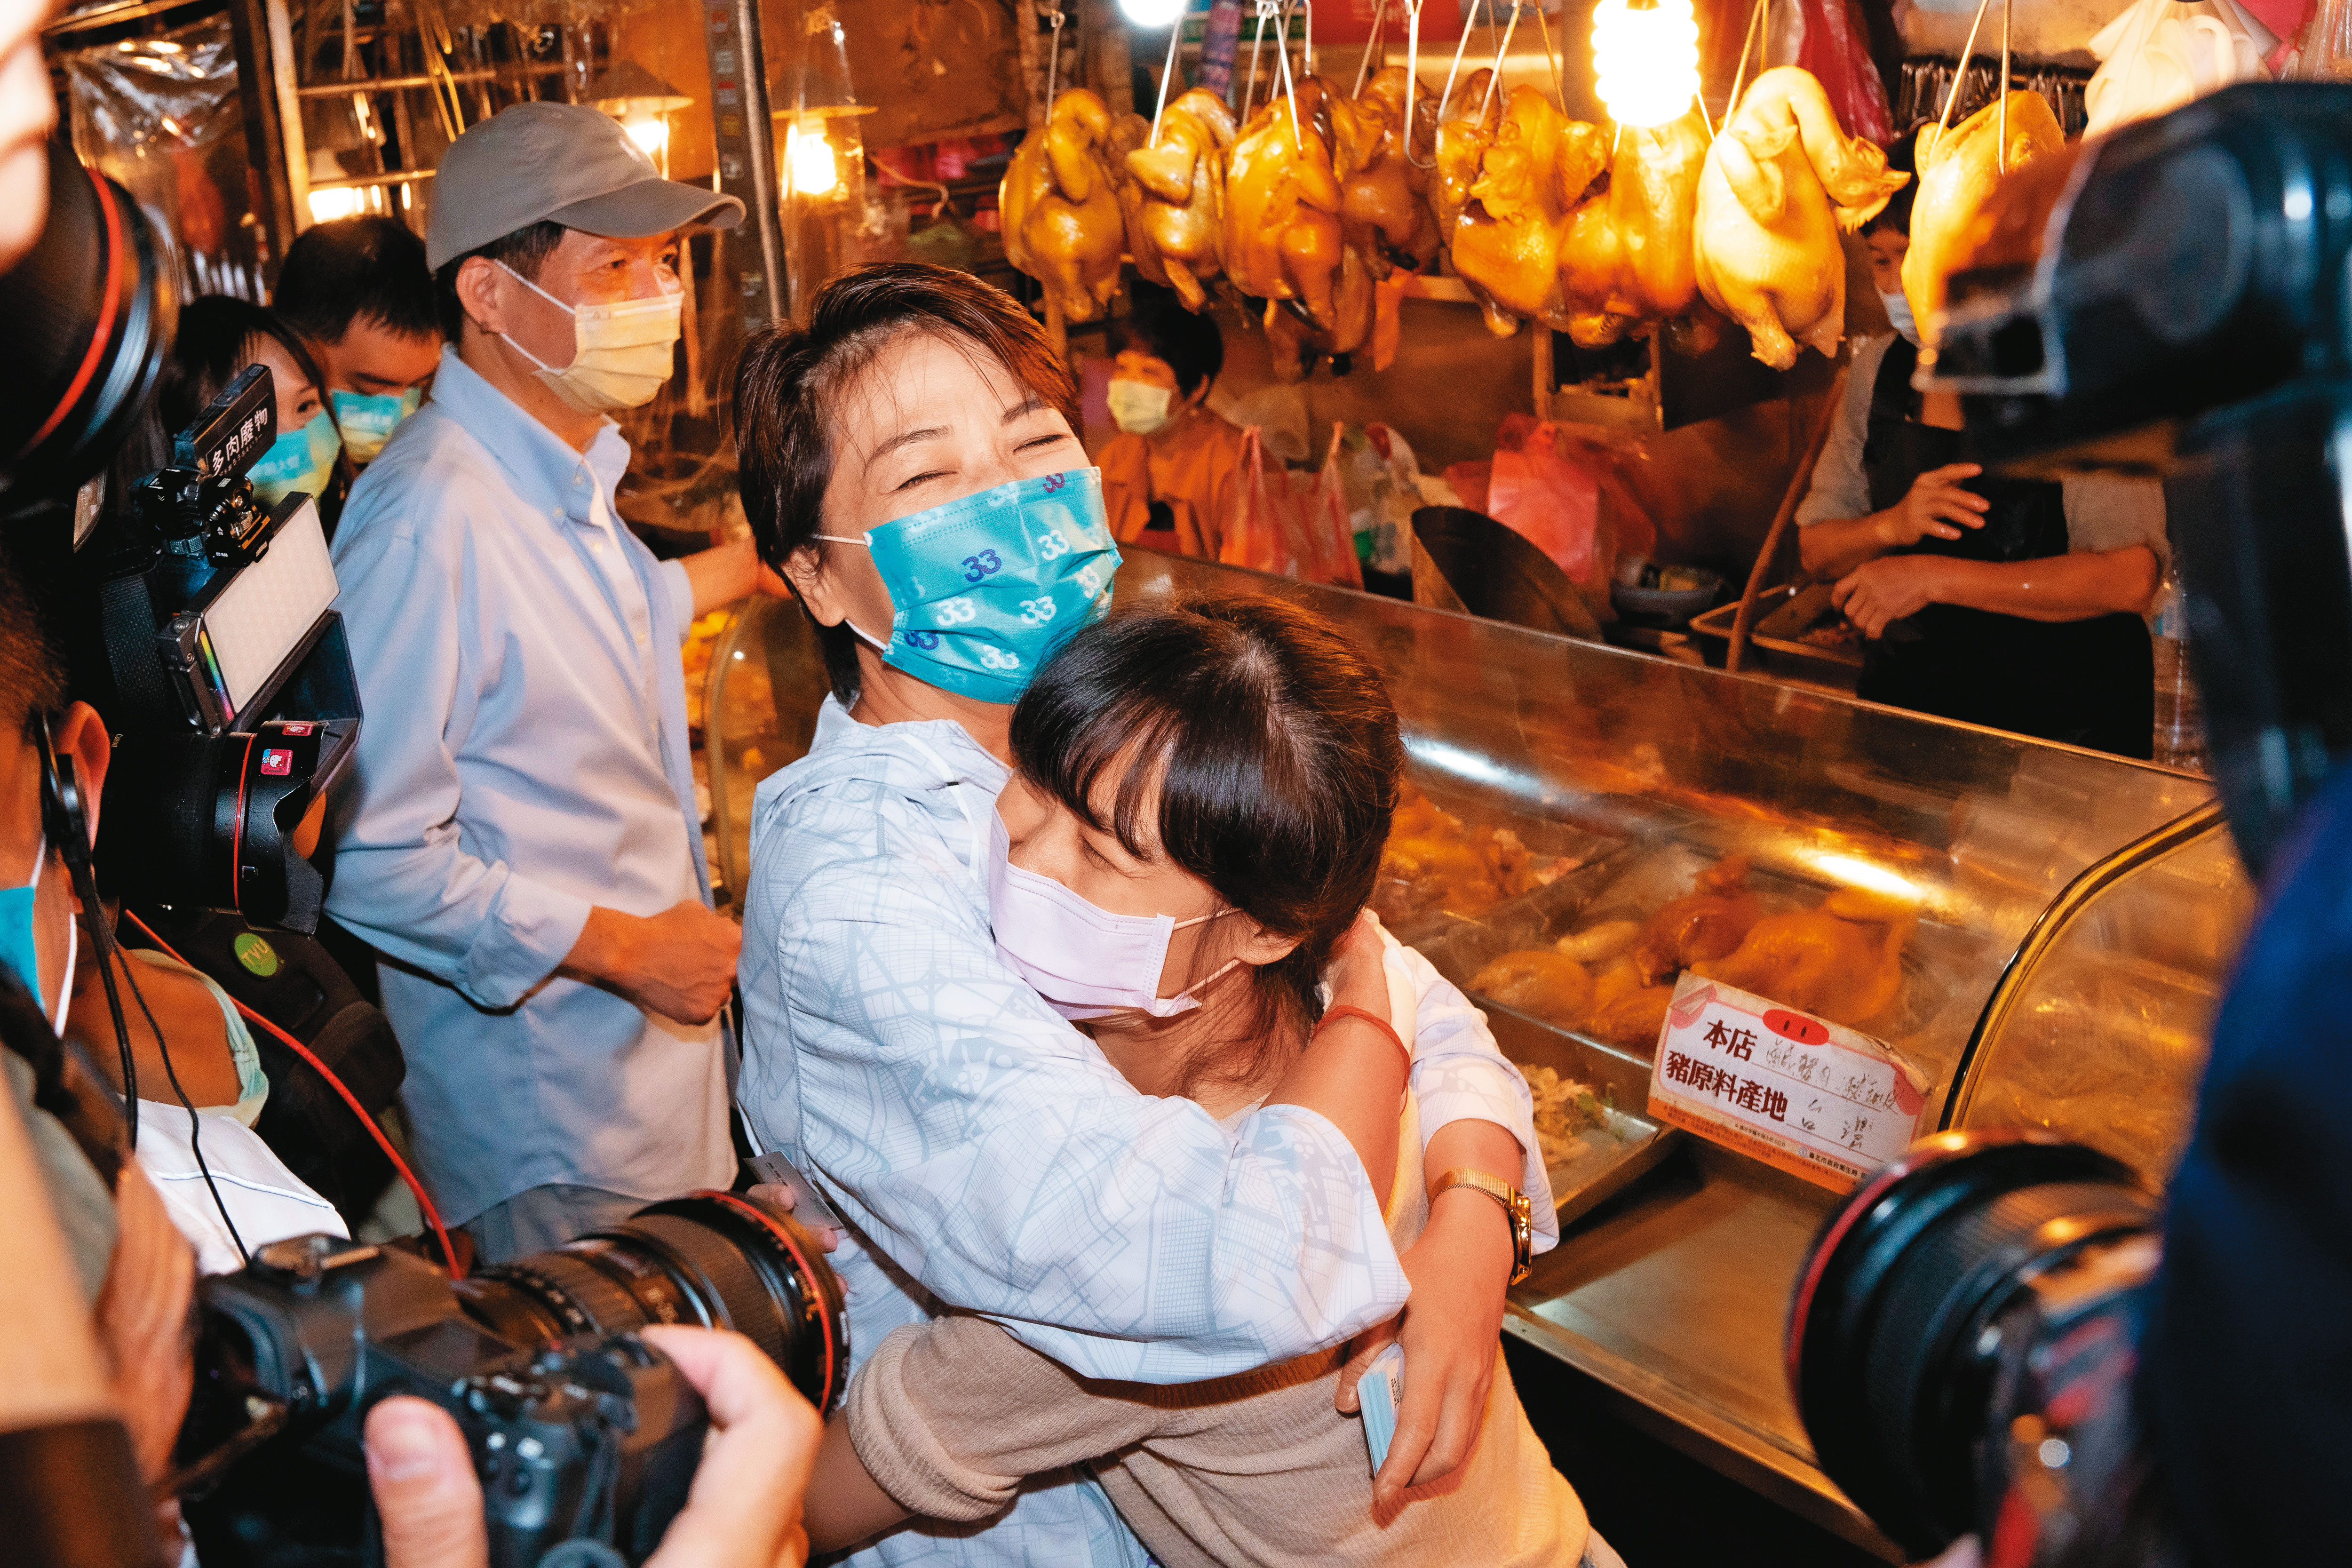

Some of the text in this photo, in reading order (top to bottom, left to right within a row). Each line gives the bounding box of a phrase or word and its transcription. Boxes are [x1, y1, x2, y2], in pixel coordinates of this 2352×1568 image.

[213, 407, 268, 476] 多肉廢物
[1038, 530, 1069, 560] 33
[962, 549, 1002, 582] 33
[937, 597, 976, 626] 33
[1019, 596, 1057, 624] 33
[241, 939, 269, 966] TVU
[1703, 1019, 1758, 1062] 本店
[1666, 1050, 1788, 1122] 豬原料產地
